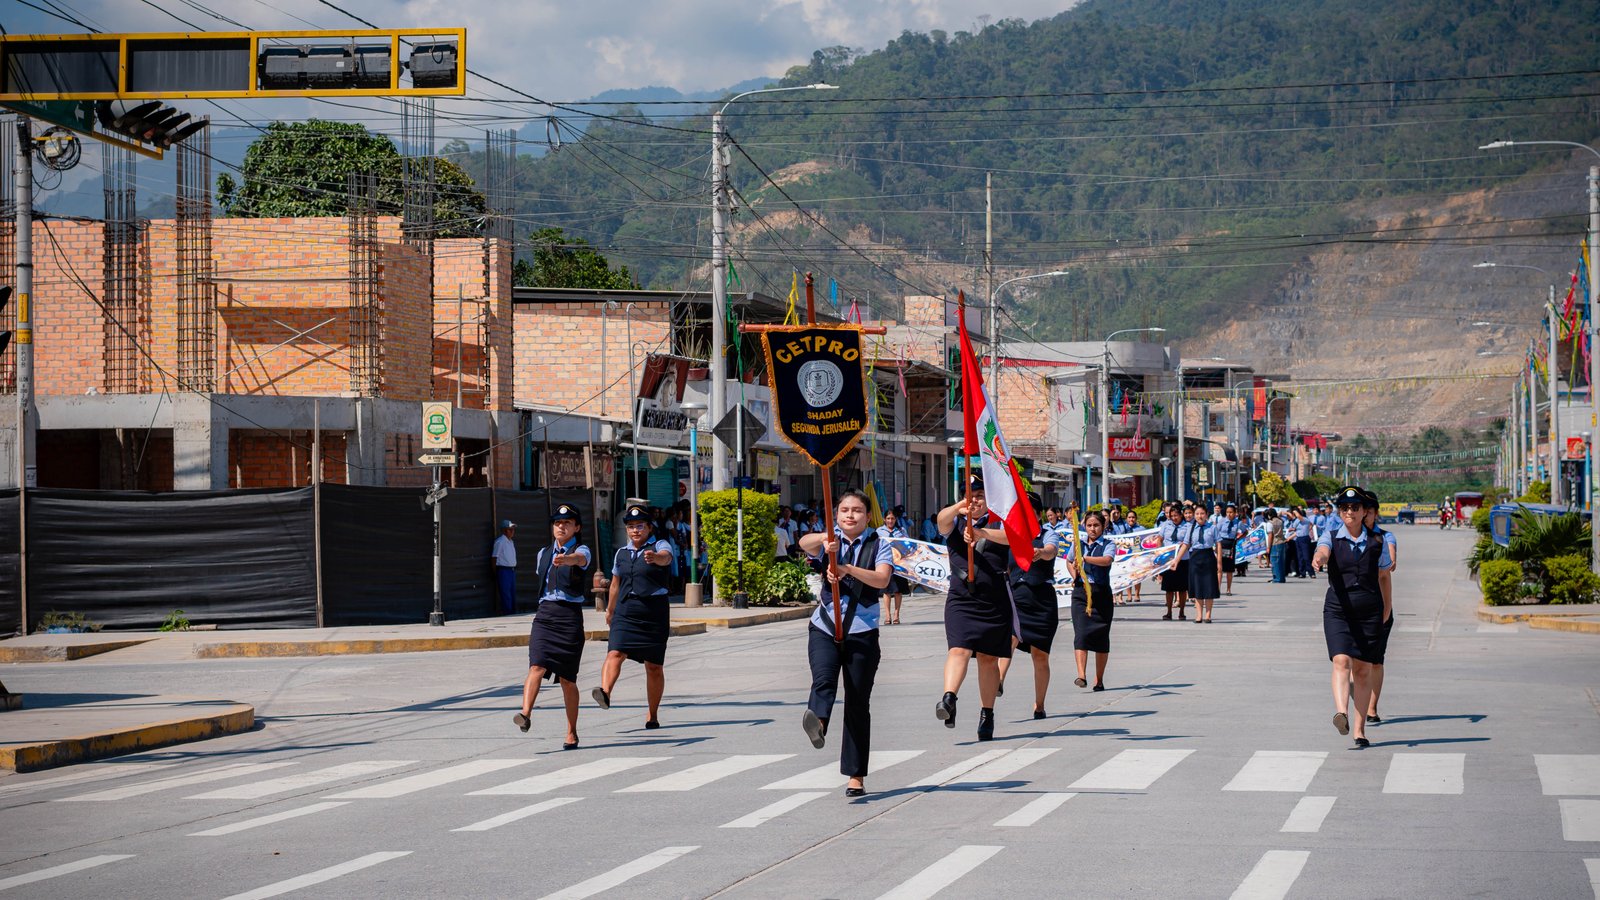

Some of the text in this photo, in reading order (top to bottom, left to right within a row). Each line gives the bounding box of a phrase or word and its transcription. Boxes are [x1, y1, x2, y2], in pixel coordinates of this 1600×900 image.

[776, 336, 859, 363] CETPRO
[807, 408, 844, 420] SHADAY
[791, 418, 860, 435] SEGUNDA JERUSALÉN
[917, 565, 943, 578] XII
